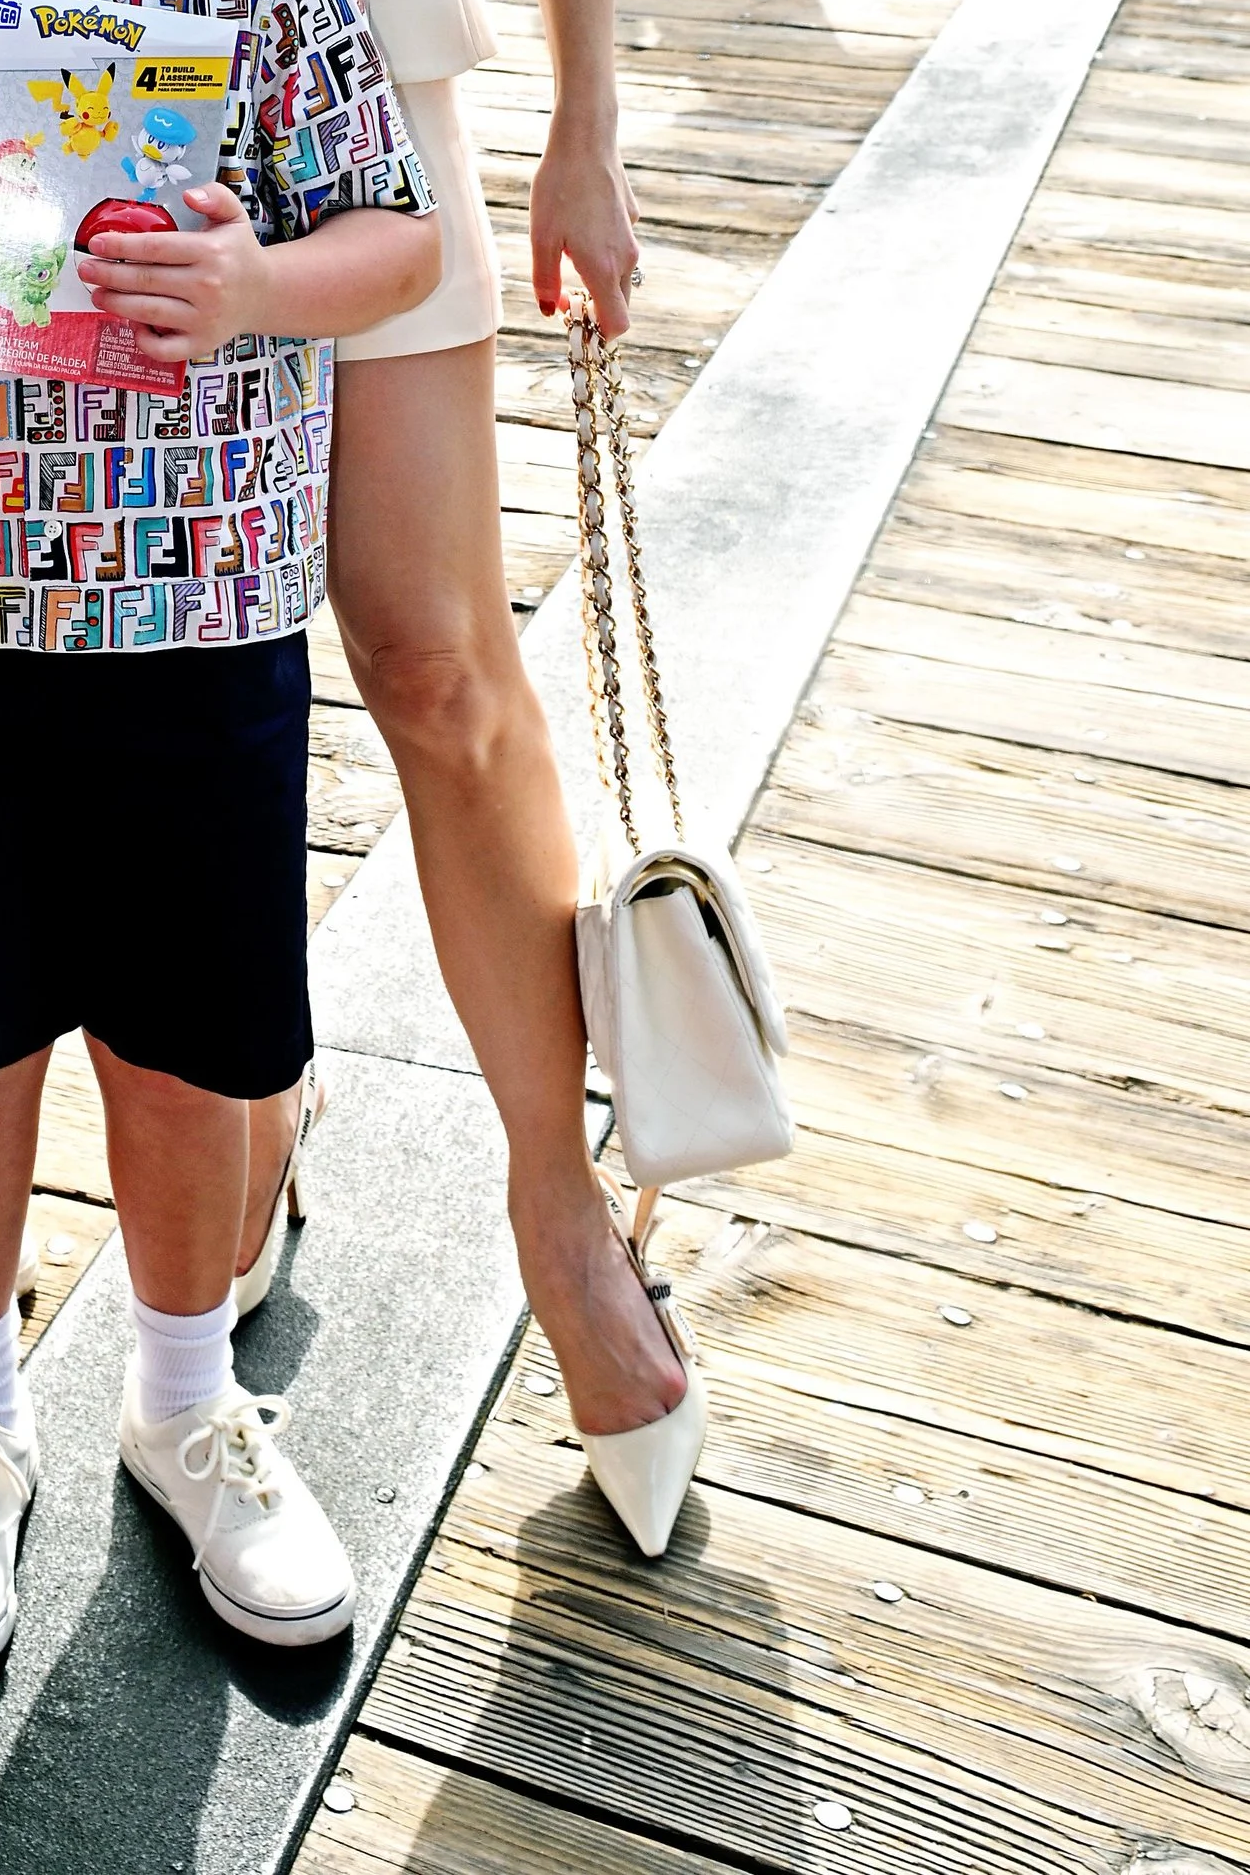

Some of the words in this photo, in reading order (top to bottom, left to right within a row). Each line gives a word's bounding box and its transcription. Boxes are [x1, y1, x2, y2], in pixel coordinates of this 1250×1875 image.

[136, 67, 157, 92] 4
[119, 327, 134, 339] WAR
[13, 338, 39, 351] TEAM
[36, 352, 50, 363] DE
[51, 355, 87, 369] PALDEA
[98, 349, 132, 363] ATTENTION:
